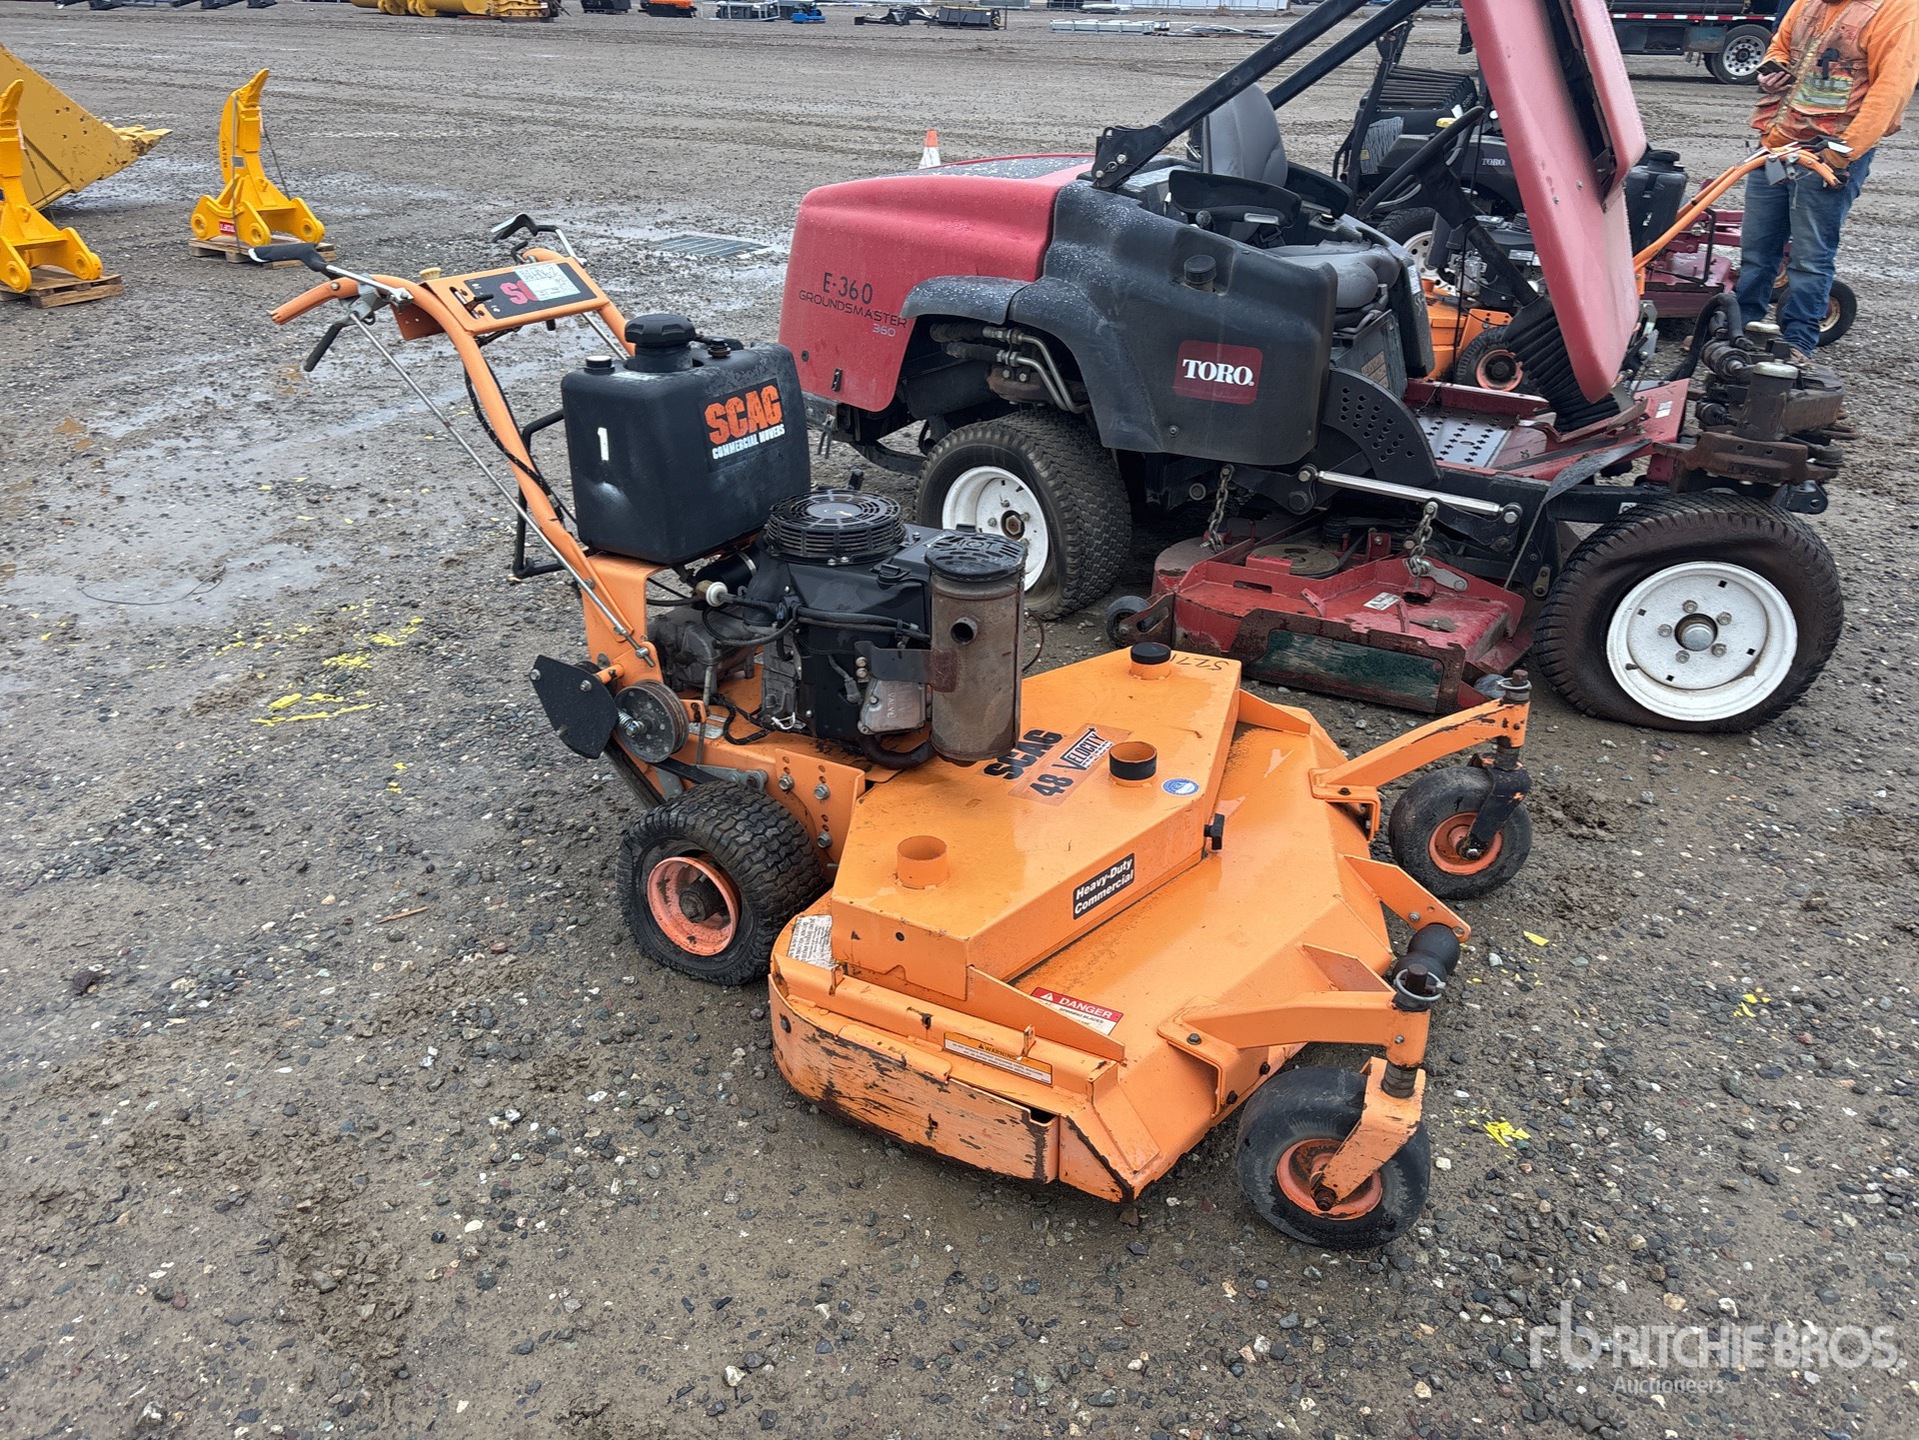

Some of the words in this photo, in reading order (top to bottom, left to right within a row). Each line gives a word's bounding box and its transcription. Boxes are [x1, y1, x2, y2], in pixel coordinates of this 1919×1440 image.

[822, 271, 873, 305] E-360
[799, 289, 908, 329] GROUNDSMASTER
[872, 323, 897, 337] 360
[704, 384, 783, 445] SCAG
[712, 433, 759, 460] COMMERCIAL
[983, 729, 1064, 780] SCAG
[1051, 726, 1108, 771] VELOCITY
[1029, 773, 1075, 798] 48
[1074, 869, 1134, 914] Commercial
[1075, 858, 1133, 901] Heavy-Duty
[1058, 996, 1113, 1019] DANGER
